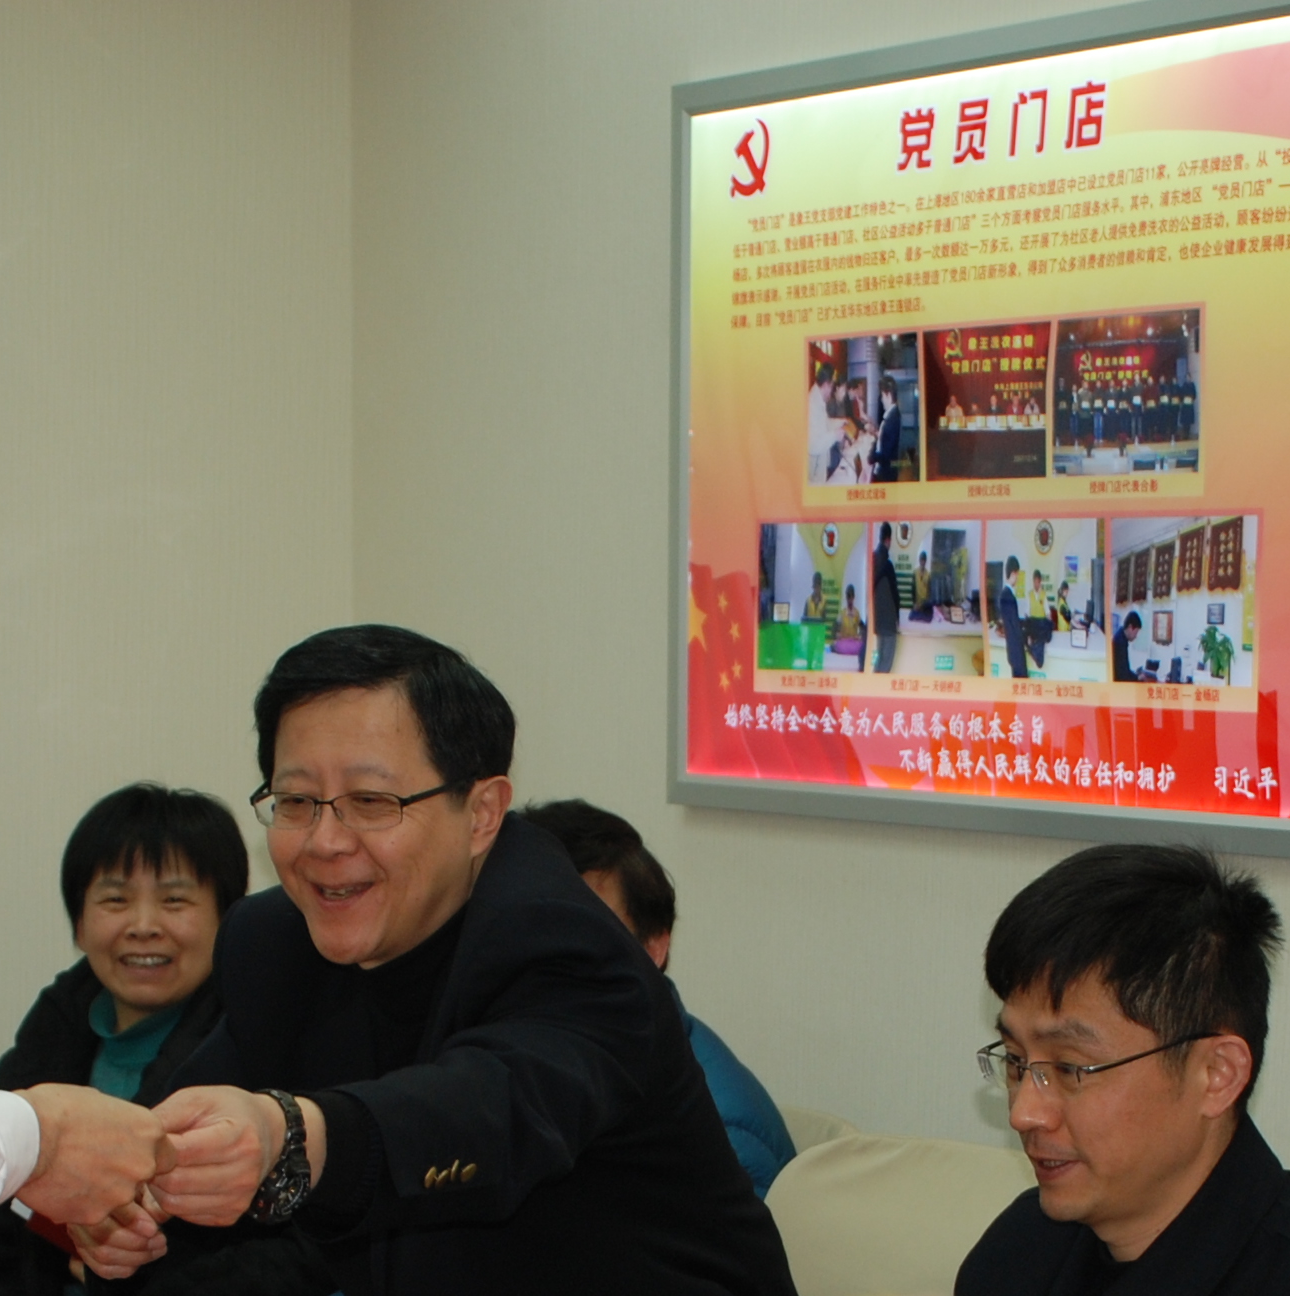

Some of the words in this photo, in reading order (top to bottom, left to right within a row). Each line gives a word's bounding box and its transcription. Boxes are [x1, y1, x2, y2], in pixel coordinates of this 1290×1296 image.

[896, 80, 1106, 171] 党员门店
[899, 747, 1177, 793] 不断赢得人民群众的信任和拥护
[1213, 766, 1279, 802] 习近平
